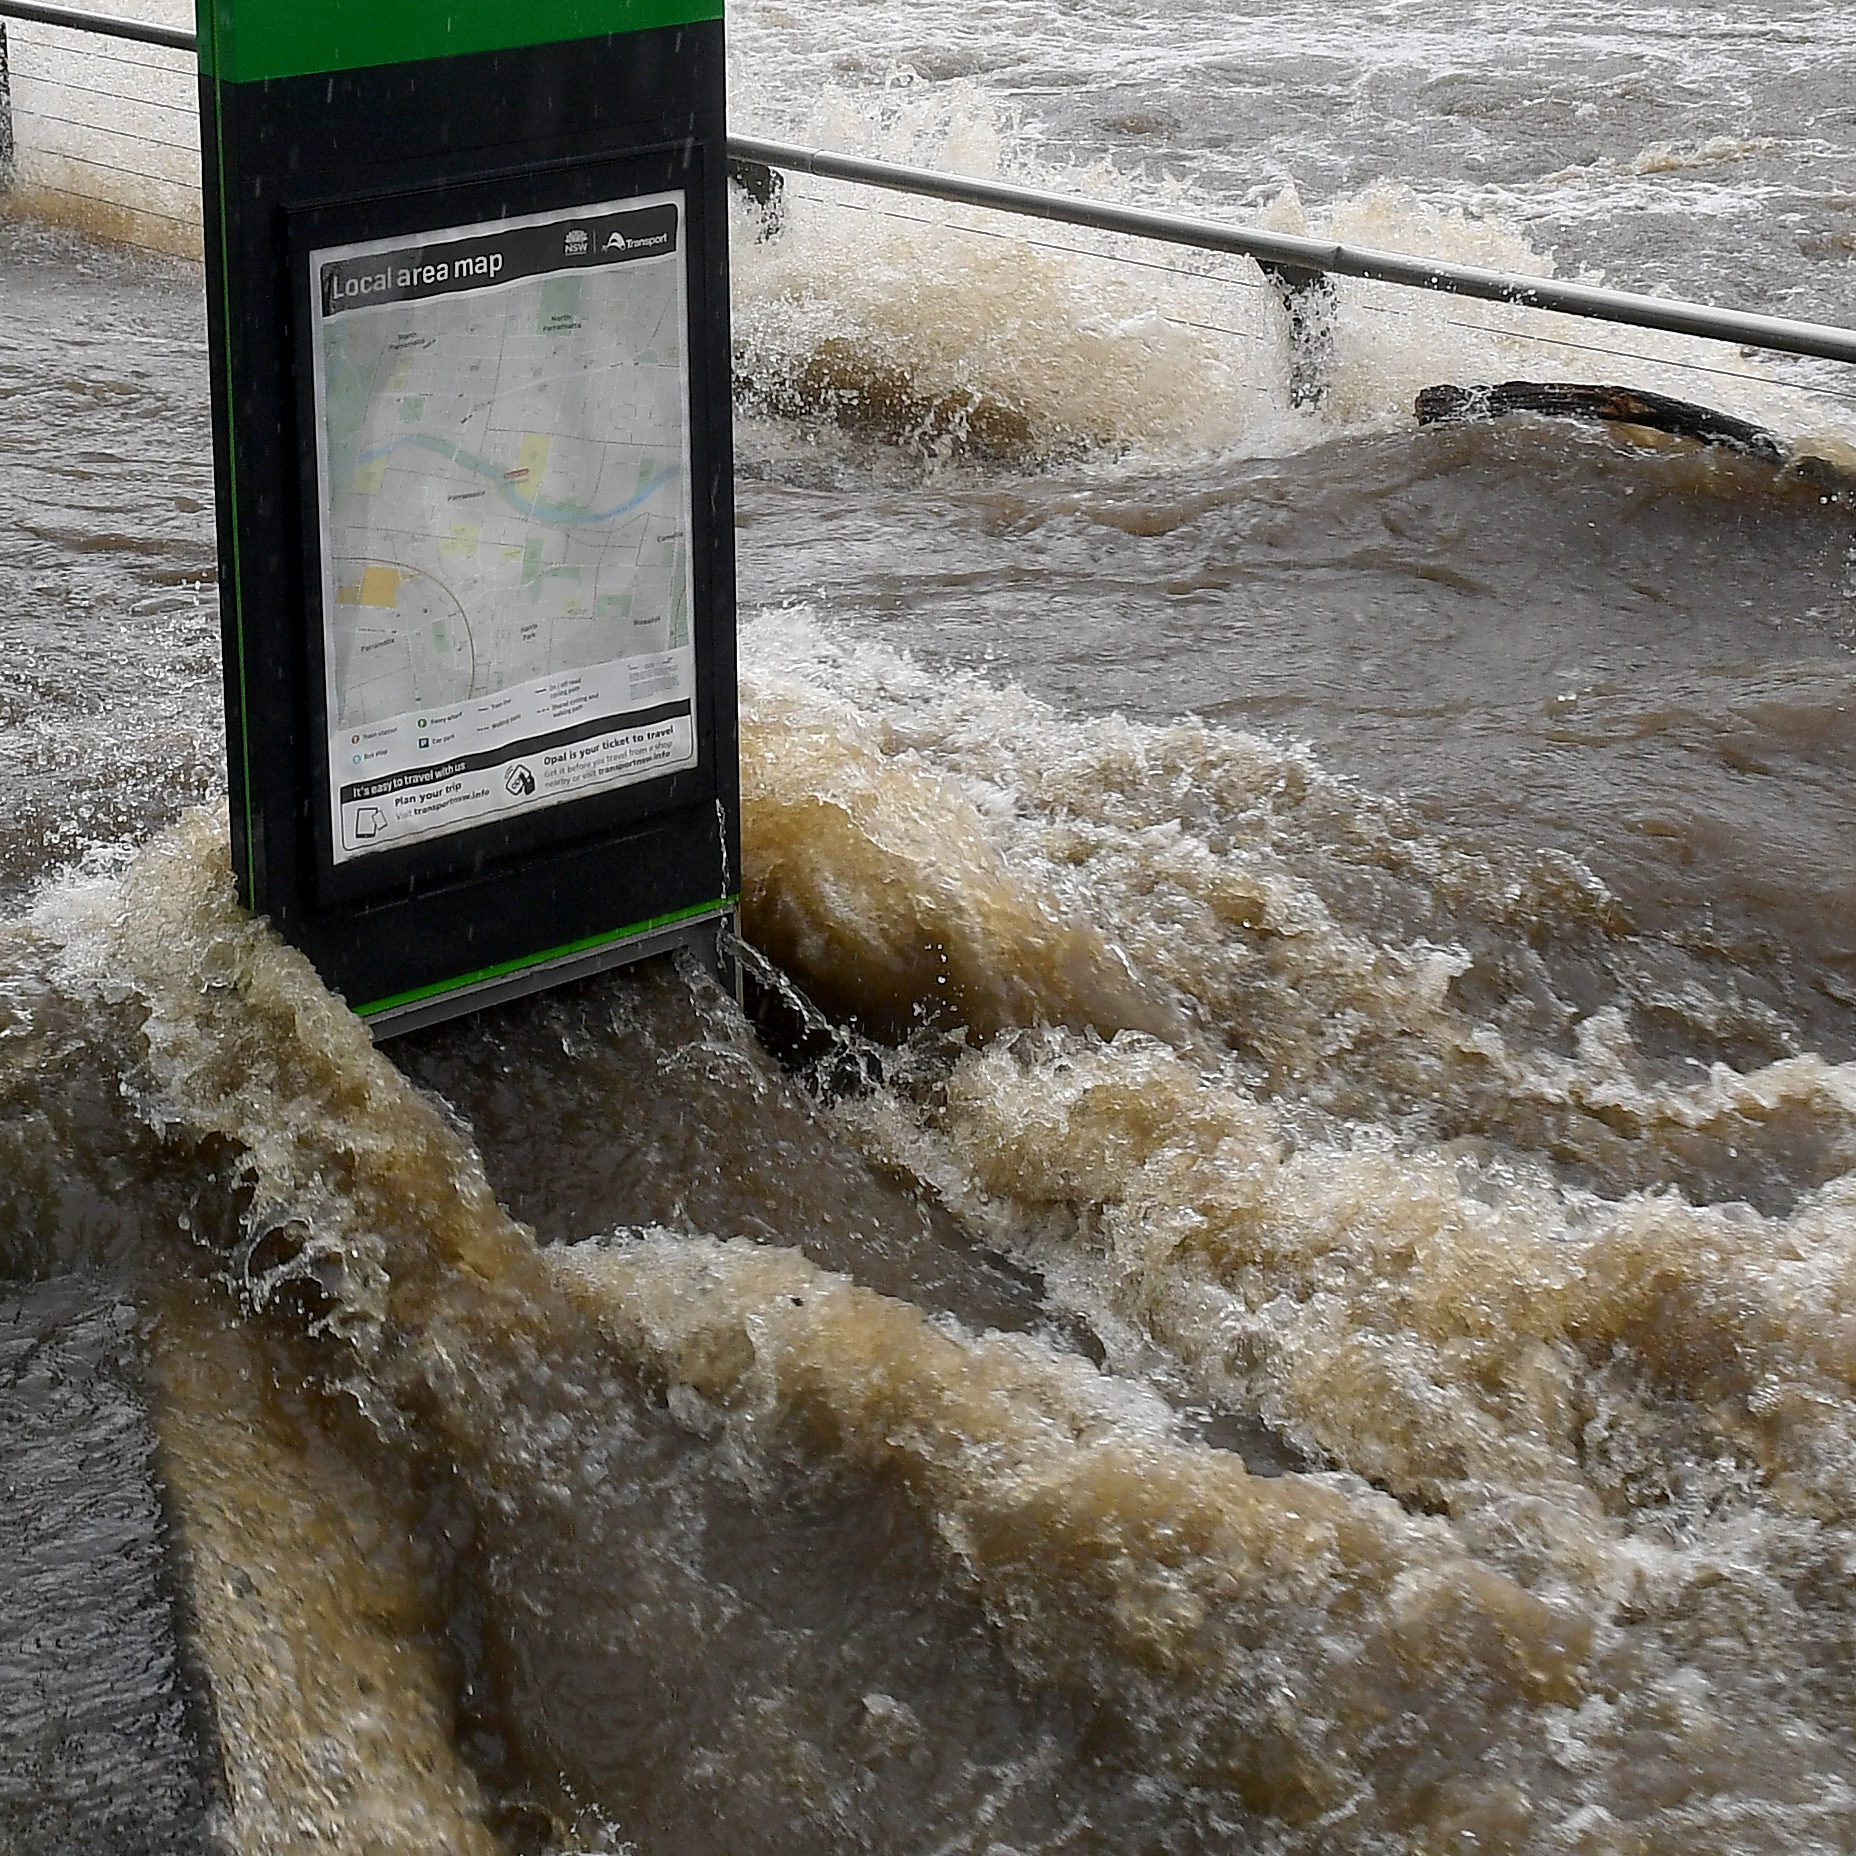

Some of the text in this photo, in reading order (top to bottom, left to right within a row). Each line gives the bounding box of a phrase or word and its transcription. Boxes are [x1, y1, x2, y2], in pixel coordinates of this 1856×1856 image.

[565, 243, 588, 253] NSW
[626, 233, 667, 249] Transport
[333, 253, 503, 299] Local area map
[544, 725, 674, 765] Opal is your ticket to travel
[354, 762, 466, 798] It's easy to travel with us
[394, 781, 462, 807] Plan your trip
